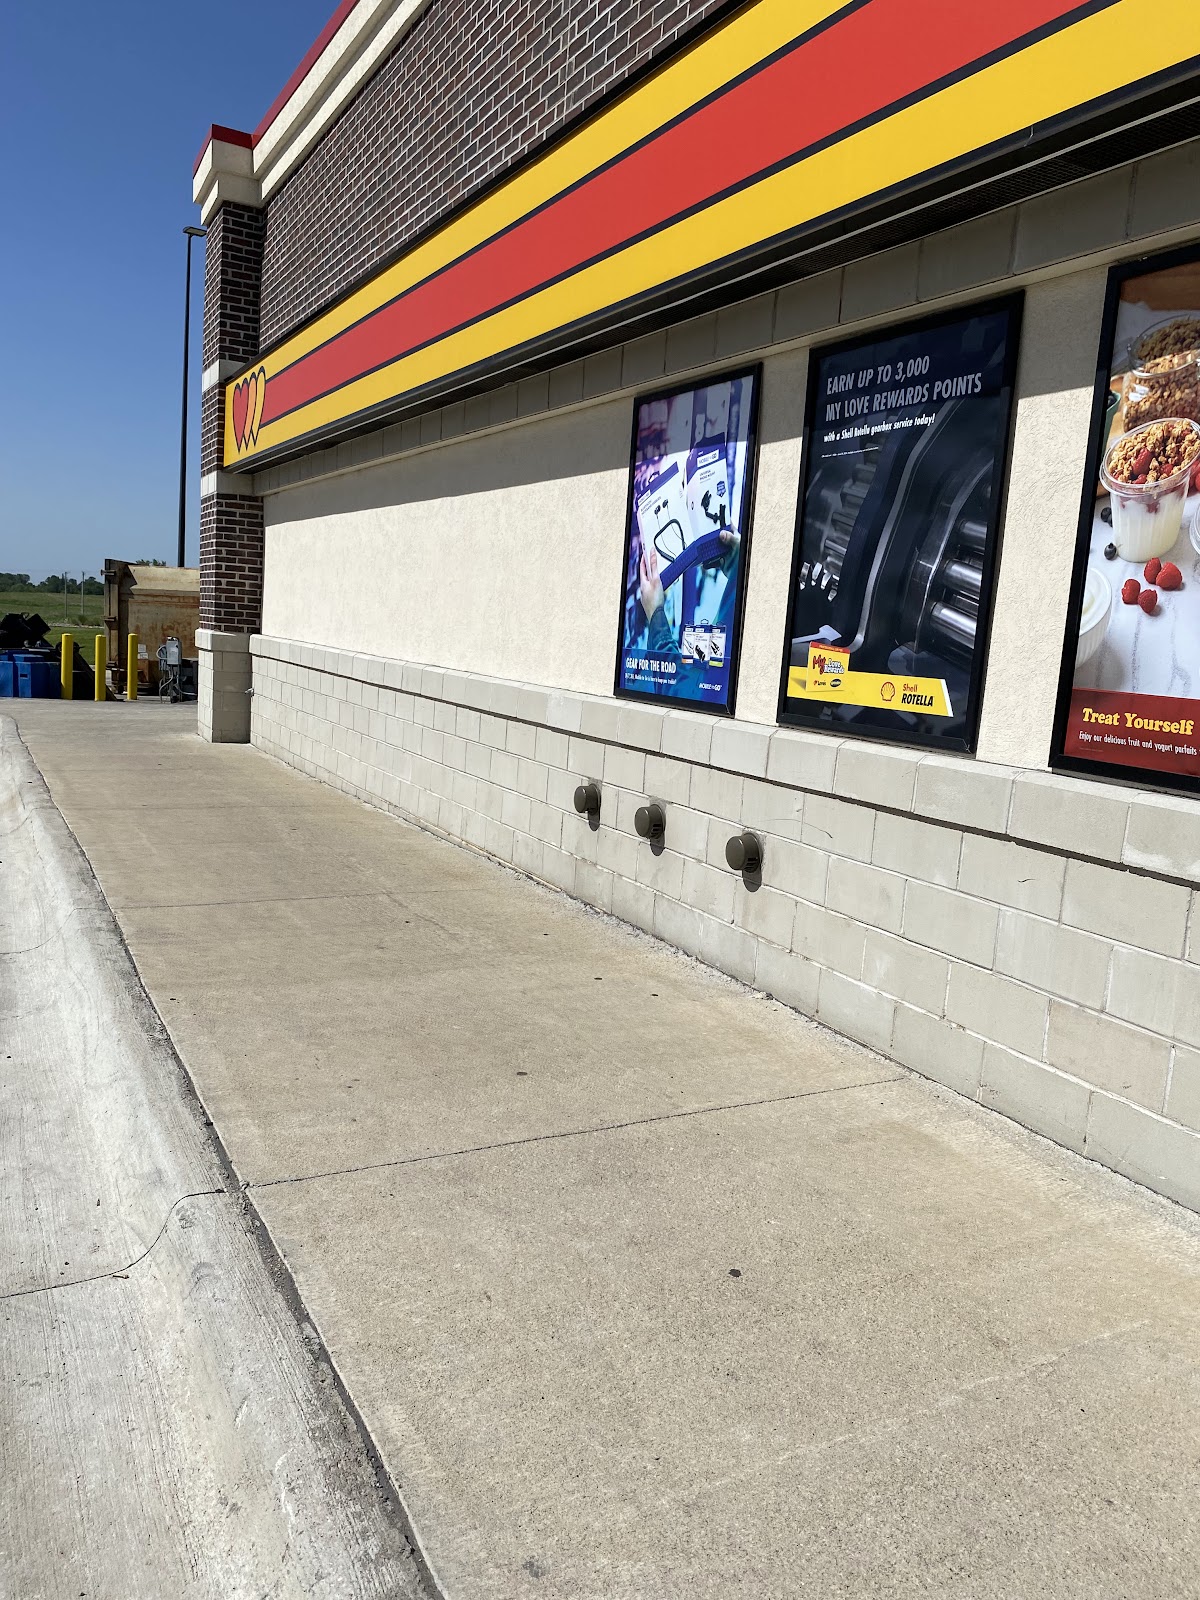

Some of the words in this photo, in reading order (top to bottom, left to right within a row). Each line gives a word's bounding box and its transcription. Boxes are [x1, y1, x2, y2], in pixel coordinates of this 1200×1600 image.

[826, 372, 855, 395] EARN
[857, 368, 874, 388] UP
[877, 364, 892, 384] TO
[895, 355, 930, 383] 3,000
[825, 400, 842, 422] MY
[844, 395, 870, 418] LOVE
[872, 383, 930, 412] REWARDS
[933, 372, 983, 401] POINTS
[823, 430, 836, 443] with
[836, 433, 840, 441] a
[841, 427, 854, 440] Shell
[854, 424, 870, 438] Rotella
[870, 420, 892, 436] gearbox
[893, 417, 913, 430] service
[914, 413, 936, 427] today!
[625, 657, 638, 669] GEAR
[638, 658, 649, 671] FOR
[649, 659, 660, 672] THE
[660, 661, 677, 674] ROAD
[812, 654, 826, 675] My
[828, 657, 841, 668] Love
[902, 683, 918, 693] Shell
[901, 693, 934, 707] ROTELLA
[1082, 707, 1120, 726] Treat
[1124, 712, 1195, 736] Yourself
[1079, 730, 1093, 742] Enjoy
[1093, 734, 1102, 742] our
[1103, 734, 1127, 746] delicious
[1127, 736, 1141, 747] fruit
[1141, 739, 1153, 749] and
[1154, 741, 1173, 753] yogurt
[1174, 743, 1198, 756] parfaits
